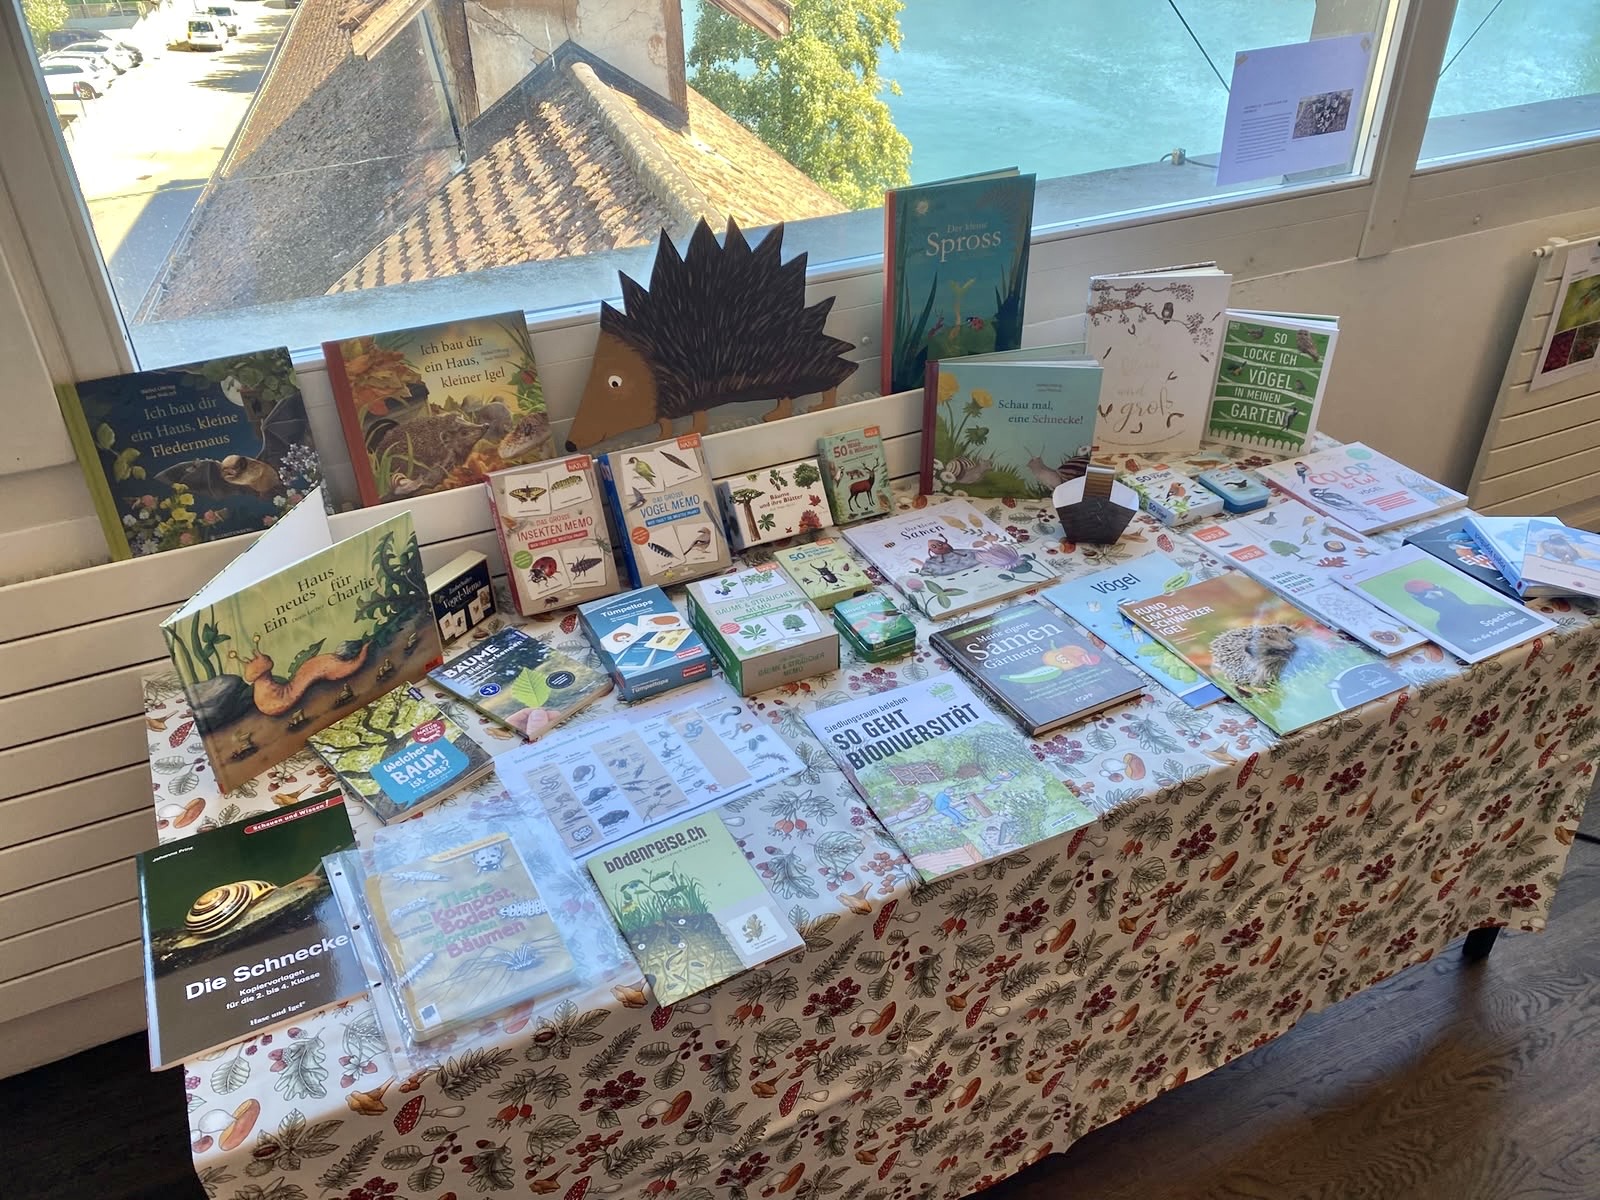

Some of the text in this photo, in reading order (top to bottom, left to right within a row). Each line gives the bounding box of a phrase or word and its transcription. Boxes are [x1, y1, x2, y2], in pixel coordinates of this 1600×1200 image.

[926, 230, 1001, 263] Spross
[419, 335, 484, 356] Ich bau dir
[1273, 332, 1288, 345] SO
[424, 360, 443, 373] ein
[445, 355, 480, 370] Haus,
[1243, 346, 1298, 366] LOCKE ICH
[440, 366, 506, 388] kleiner Igel
[1248, 366, 1294, 390] VÖGEL
[998, 399, 1054, 411] Schau mal,
[1234, 387, 1282, 404] IN MEINEN
[144, 397, 218, 421] Ich bau dir
[1008, 414, 1084, 425] eine Schnecke!
[1230, 403, 1286, 426] GARTEN
[130, 412, 239, 443] ein Haus, kleine
[151, 433, 231, 458] Fledermaus
[833, 444, 848, 458] 50
[1308, 462, 1377, 486] COLOR
[640, 502, 670, 518] VOGEL
[671, 494, 701, 510] MEMO
[517, 516, 593, 542] INSEKTEN MEMO
[900, 525, 945, 541] Samen
[788, 552, 806, 562] 50
[297, 568, 335, 593] Haus
[327, 577, 376, 607] Charlie
[1090, 572, 1142, 595] Vögel
[275, 574, 353, 616] neues für
[600, 599, 654, 618] Tümpeltaps
[1133, 602, 1168, 617] RUND
[1141, 604, 1190, 623] UM DEN
[1150, 606, 1215, 630] SCHWEIZER
[1480, 610, 1517, 627] Spechte
[263, 617, 289, 635] Ein
[975, 622, 1031, 643] Meine eigene
[1158, 625, 1188, 636] IGEL
[966, 623, 1064, 660] Samen
[442, 644, 500, 678] BÄUME
[466, 661, 488, 675] Blatt
[487, 639, 526, 663] erkennen
[983, 644, 1043, 669] Gärtnerei
[824, 695, 909, 734] Siedlungsraum beleben
[832, 708, 910, 751] SO GEHT
[846, 703, 980, 771] BIODIVERSITÄT
[383, 744, 428, 773] Welcher
[389, 749, 447, 785] BAUM
[408, 775, 427, 789] ist
[426, 759, 451, 779] das?
[253, 817, 283, 832] Schauen
[284, 812, 298, 822] und
[438, 882, 495, 909] Tiere
[440, 906, 499, 935] Boden
[446, 920, 528, 959] Bäumen
[185, 934, 350, 1001] Die Schnecke
[226, 971, 321, 1010] für die 2. bis 4. Klasse
[239, 968, 305, 997] Kopiervorlagen
[250, 1014, 271, 1027] Hase
[271, 1008, 287, 1019] und
